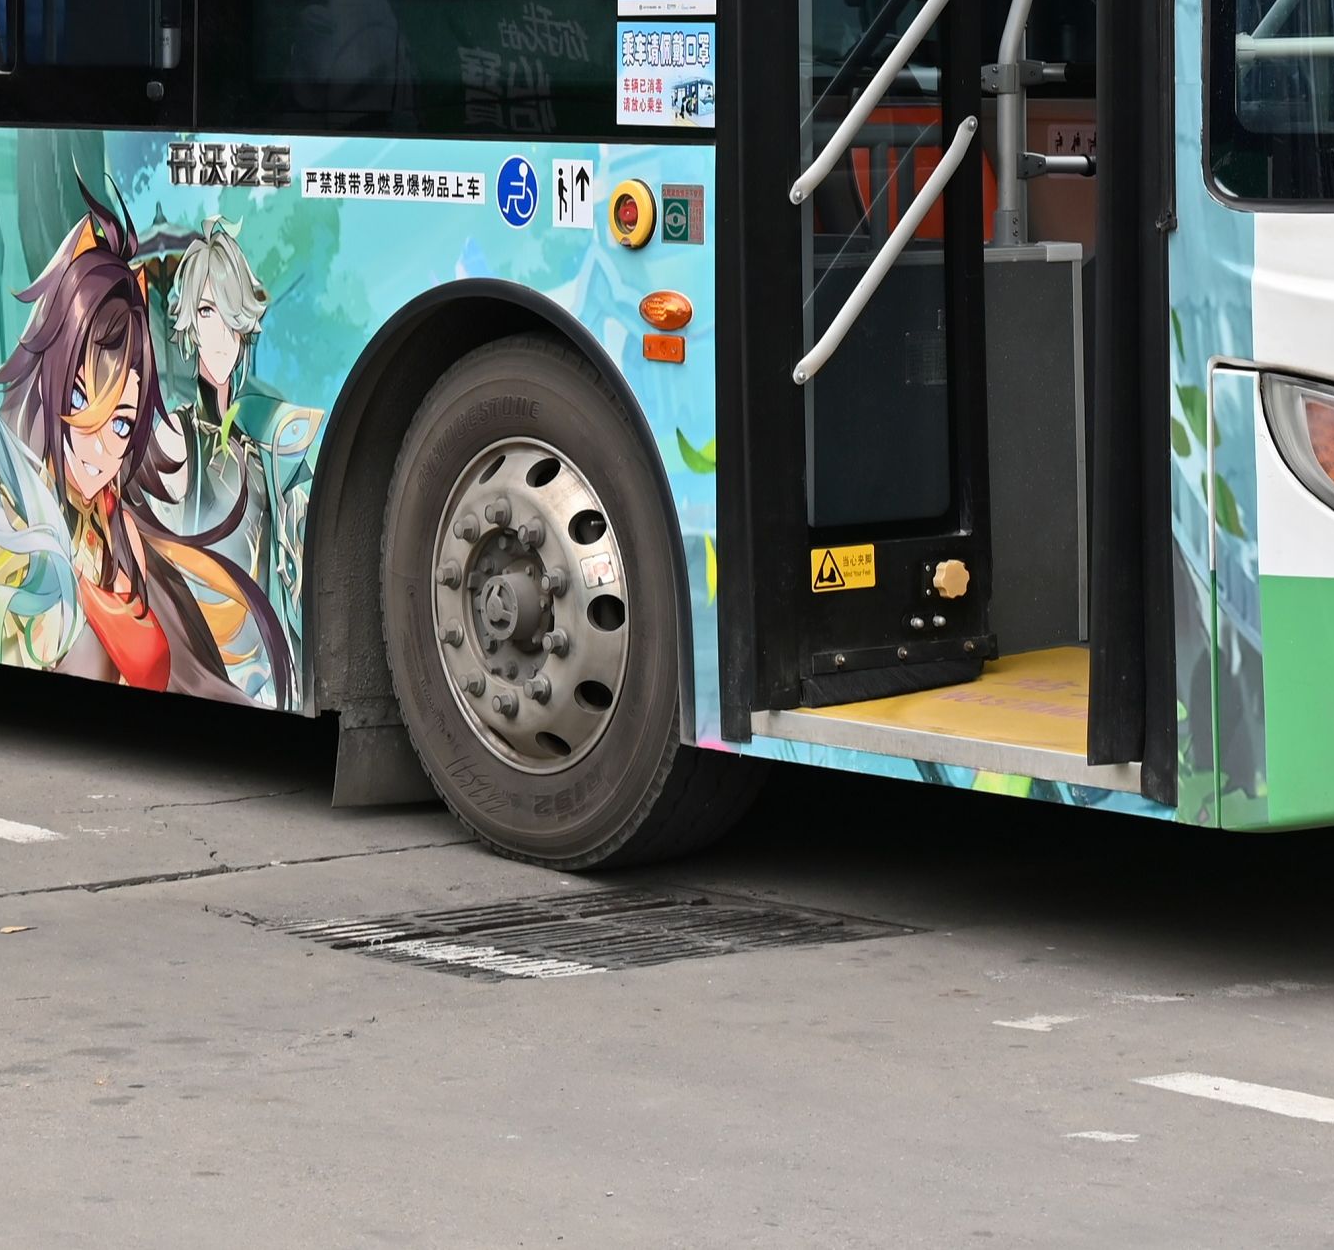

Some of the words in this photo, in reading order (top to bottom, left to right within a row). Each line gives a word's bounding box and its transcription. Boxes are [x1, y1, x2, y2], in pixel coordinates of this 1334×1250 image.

[622, 30, 711, 68] 乘车请佩戴口罩
[623, 77, 664, 94] 车辆已消毒
[623, 96, 663, 113] 请放心乘坐
[167, 141, 292, 188] 开沃汽车
[305, 171, 481, 200] 严禁携带易燃易爆物品上车
[842, 553, 872, 567] 当心夹脚
